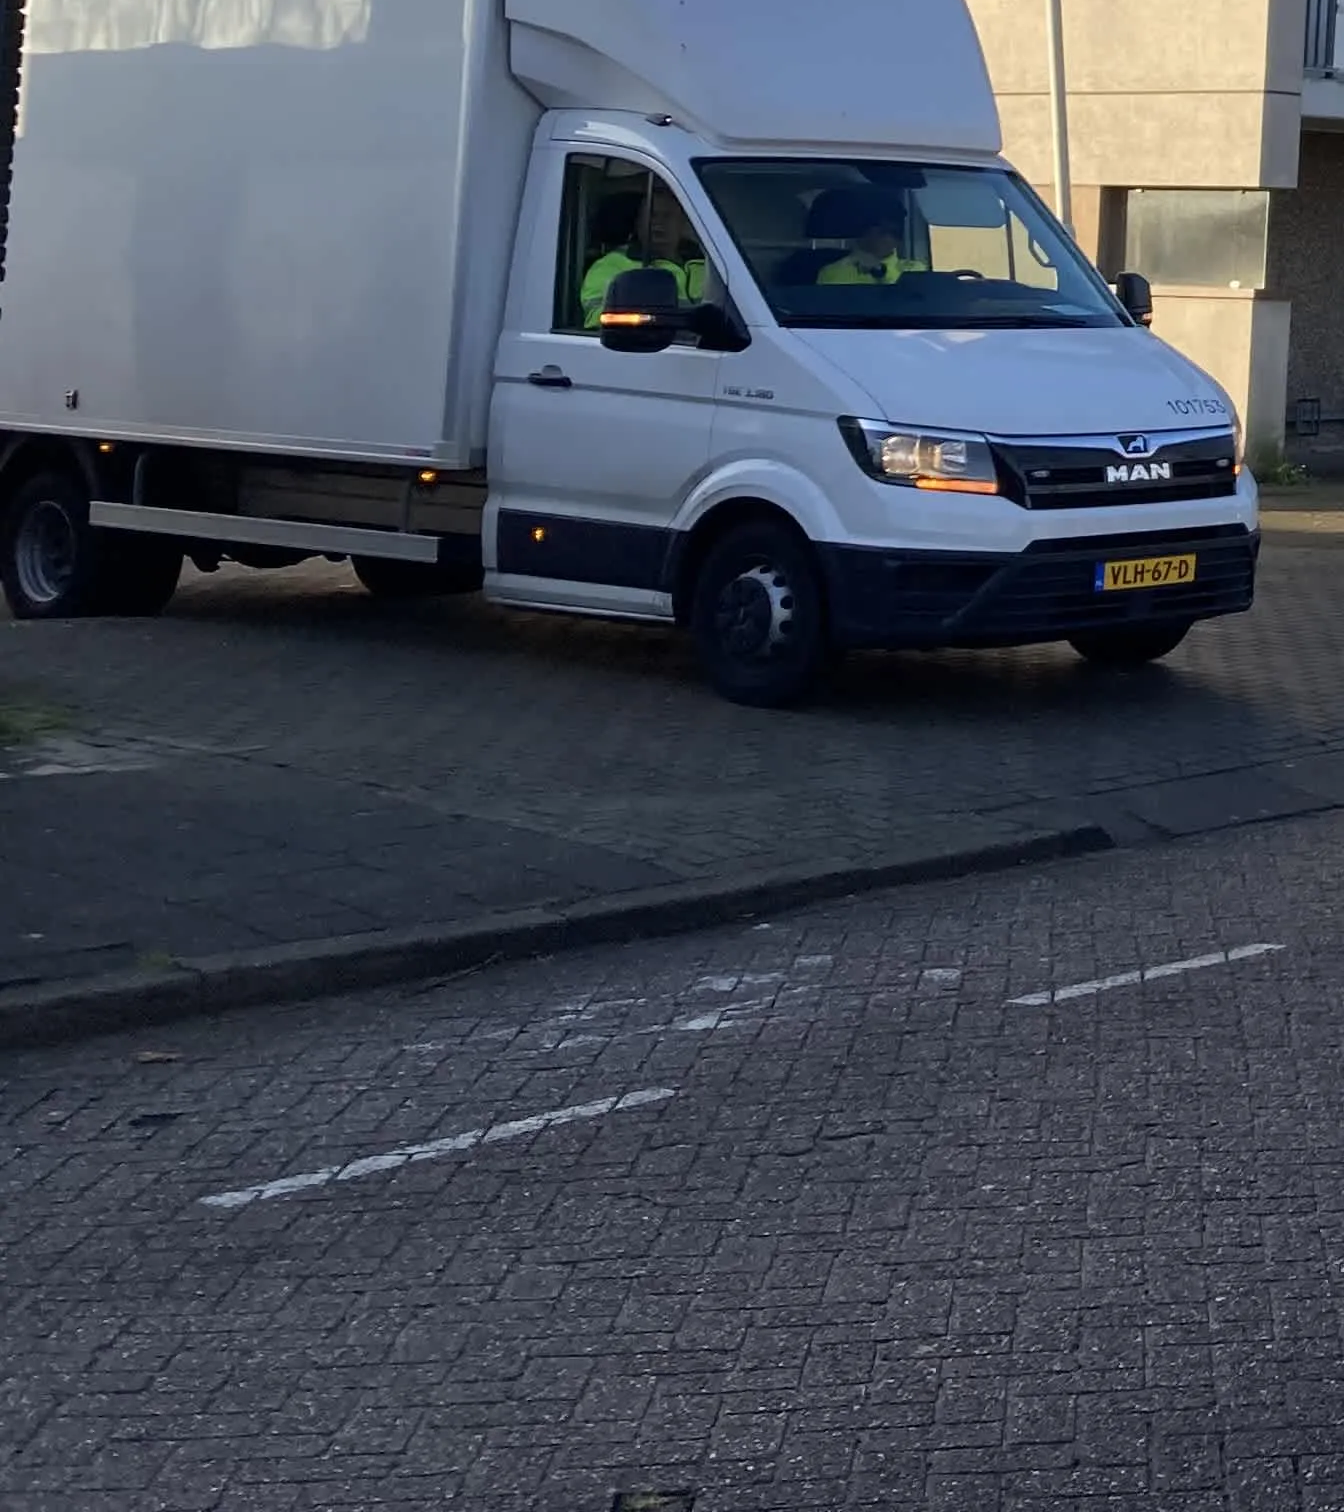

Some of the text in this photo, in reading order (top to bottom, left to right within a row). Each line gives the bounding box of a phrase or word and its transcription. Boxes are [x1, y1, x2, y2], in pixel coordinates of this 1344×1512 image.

[1166, 399, 1226, 415] 101753
[1106, 462, 1171, 484] MAN
[1111, 559, 1189, 587] VLH-67-D
